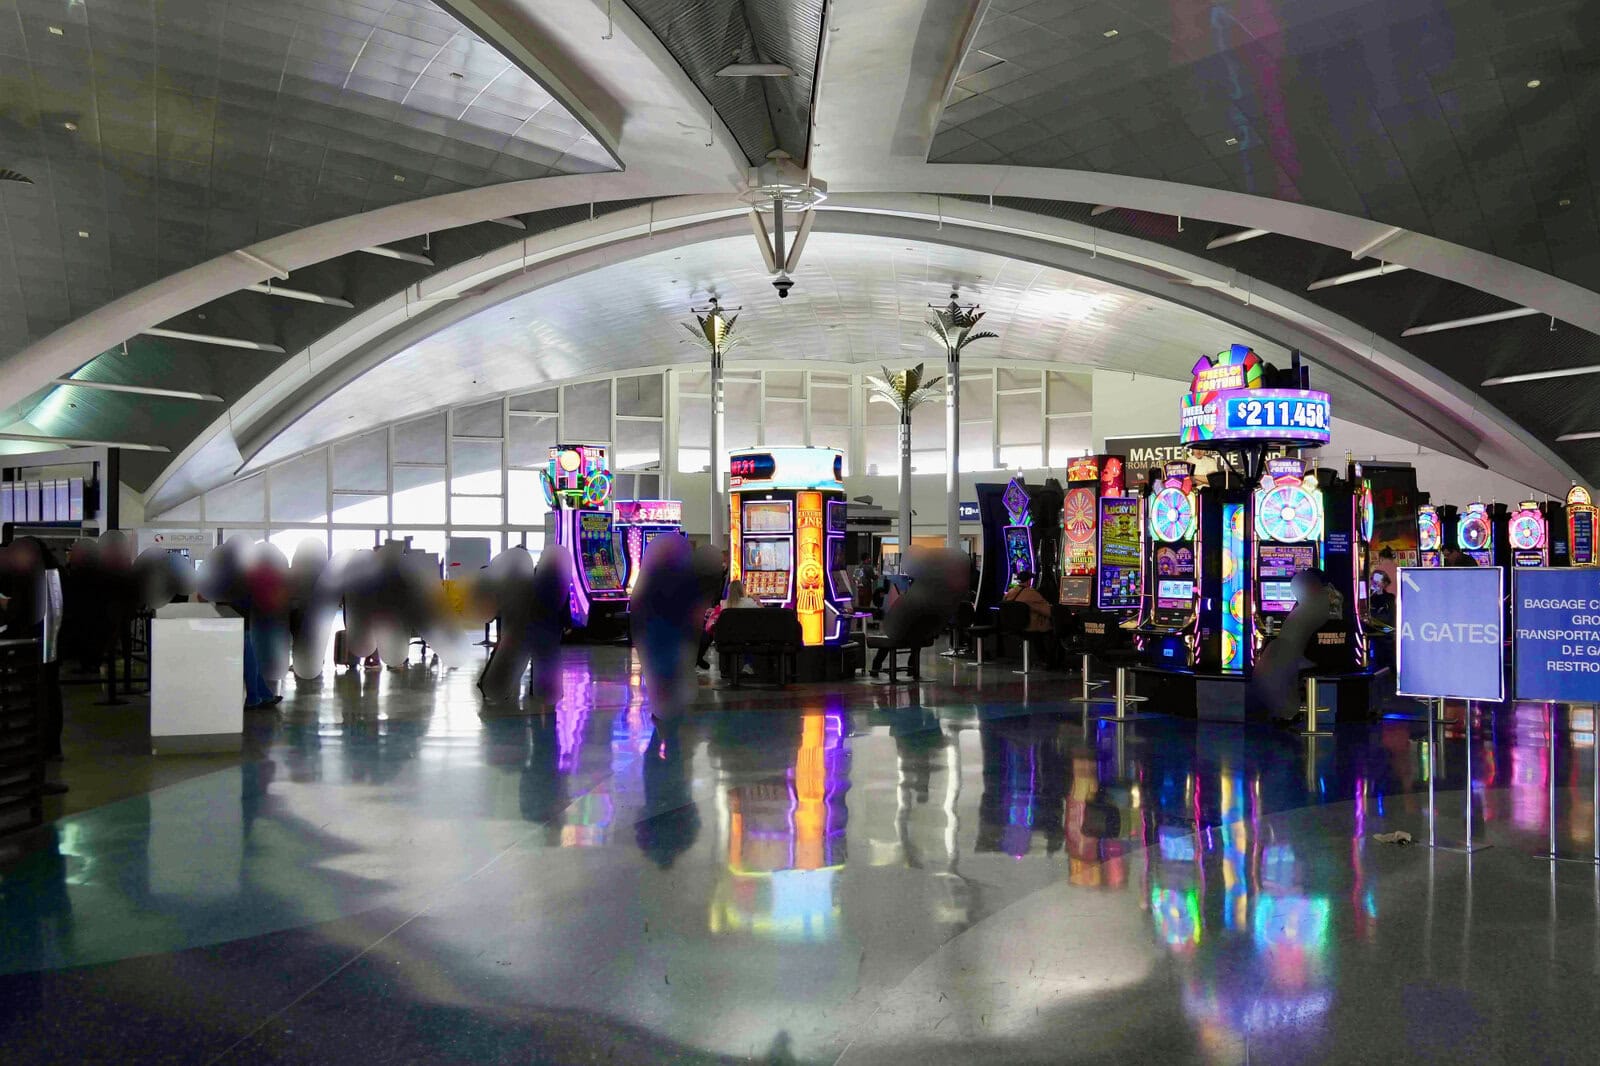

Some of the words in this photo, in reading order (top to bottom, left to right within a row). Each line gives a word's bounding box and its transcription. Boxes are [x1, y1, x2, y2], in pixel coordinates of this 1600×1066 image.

[1182, 413, 1217, 427] FORTUNE
[1524, 599, 1586, 610] BAGGAGE
[1589, 599, 1600, 610] C
[1401, 621, 1415, 641] A
[1420, 622, 1499, 645] GATES
[1562, 645, 1584, 657] D,E
